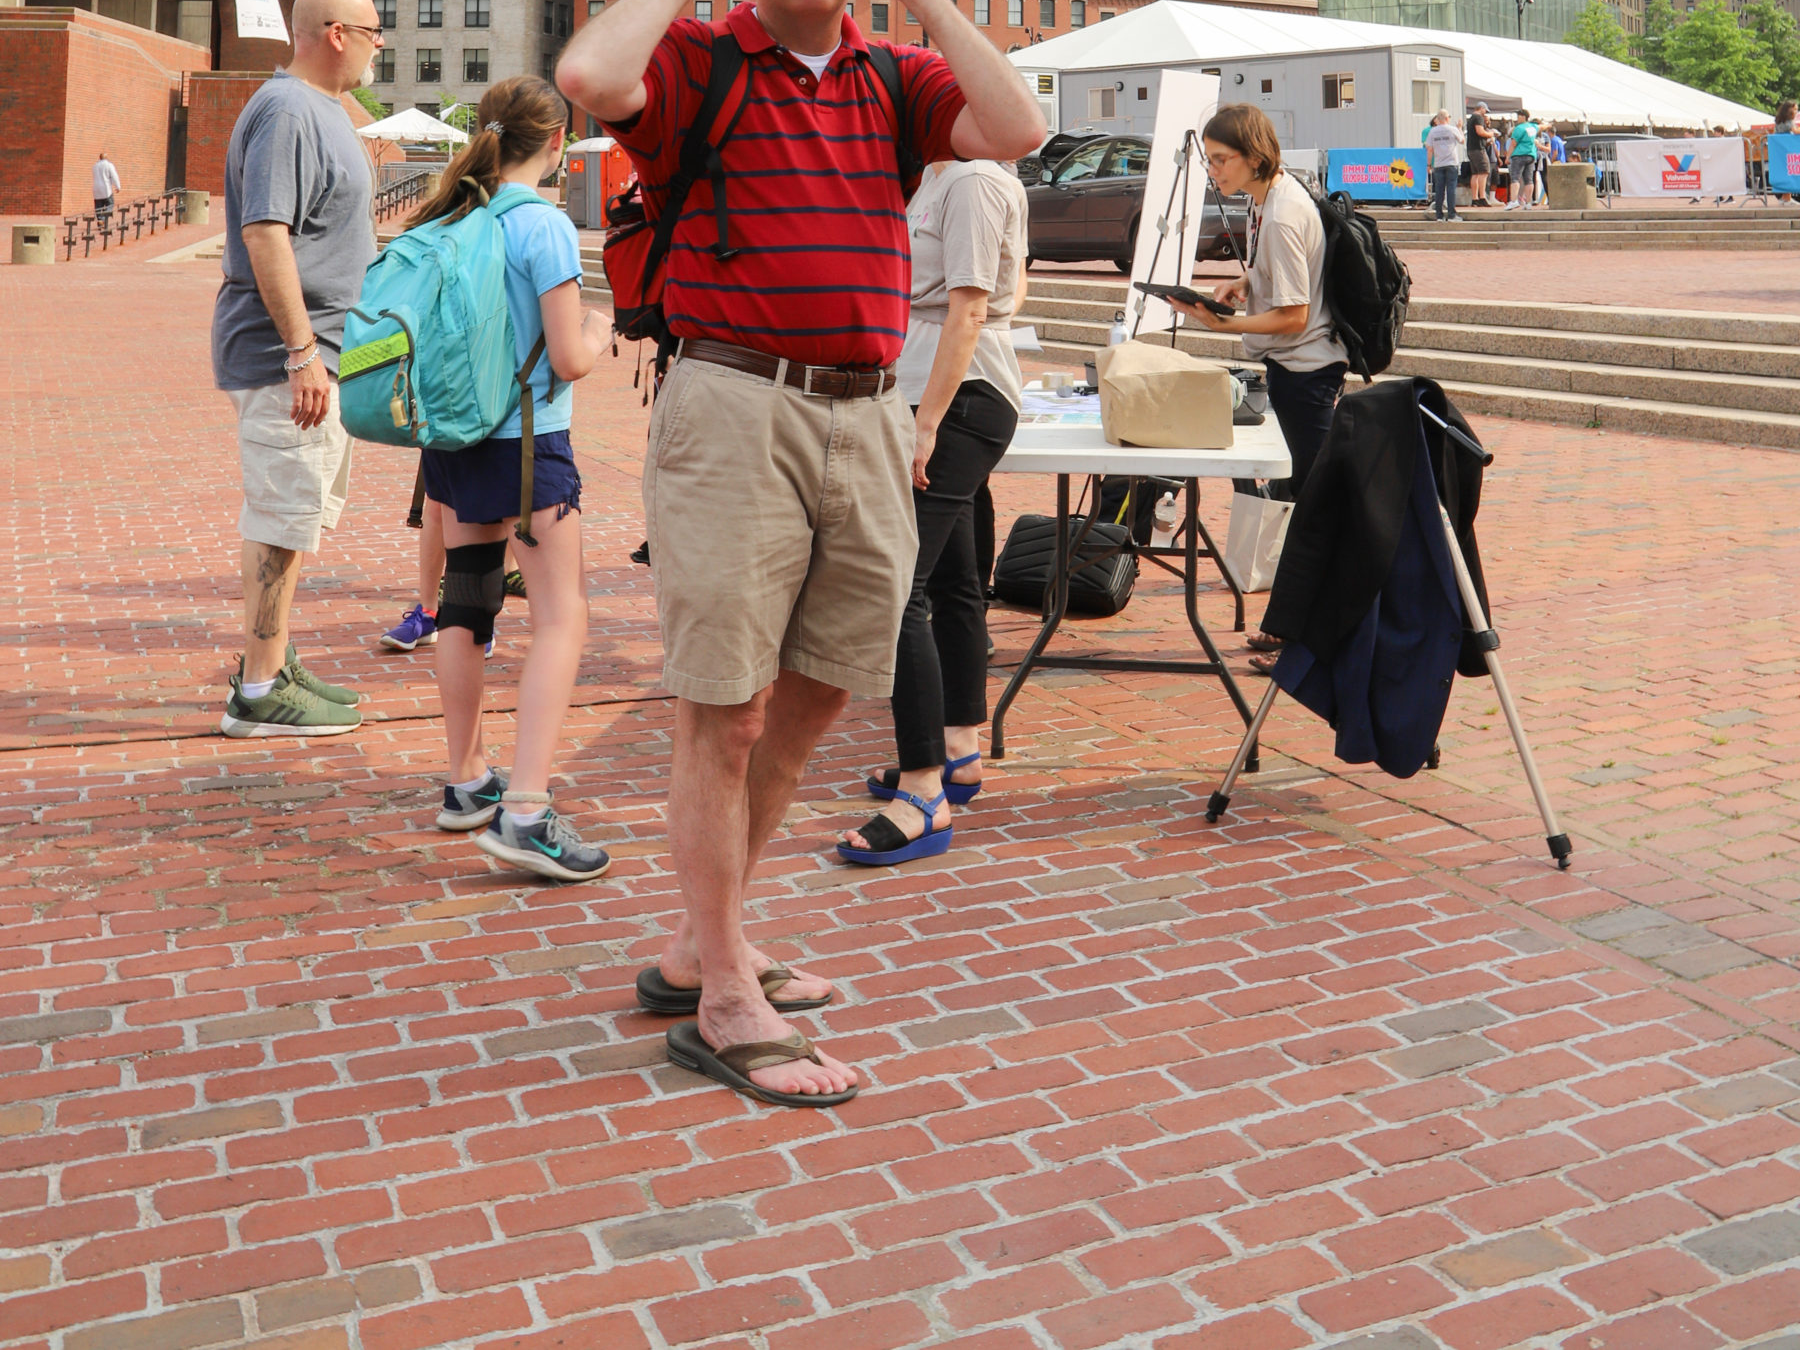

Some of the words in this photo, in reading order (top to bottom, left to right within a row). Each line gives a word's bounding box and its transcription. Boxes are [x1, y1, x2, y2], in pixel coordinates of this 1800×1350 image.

[1343, 165, 1366, 173] JIMMY
[1368, 165, 1388, 173] FUND
[1343, 174, 1368, 183] SCOOPER
[1370, 174, 1388, 183] BOWL
